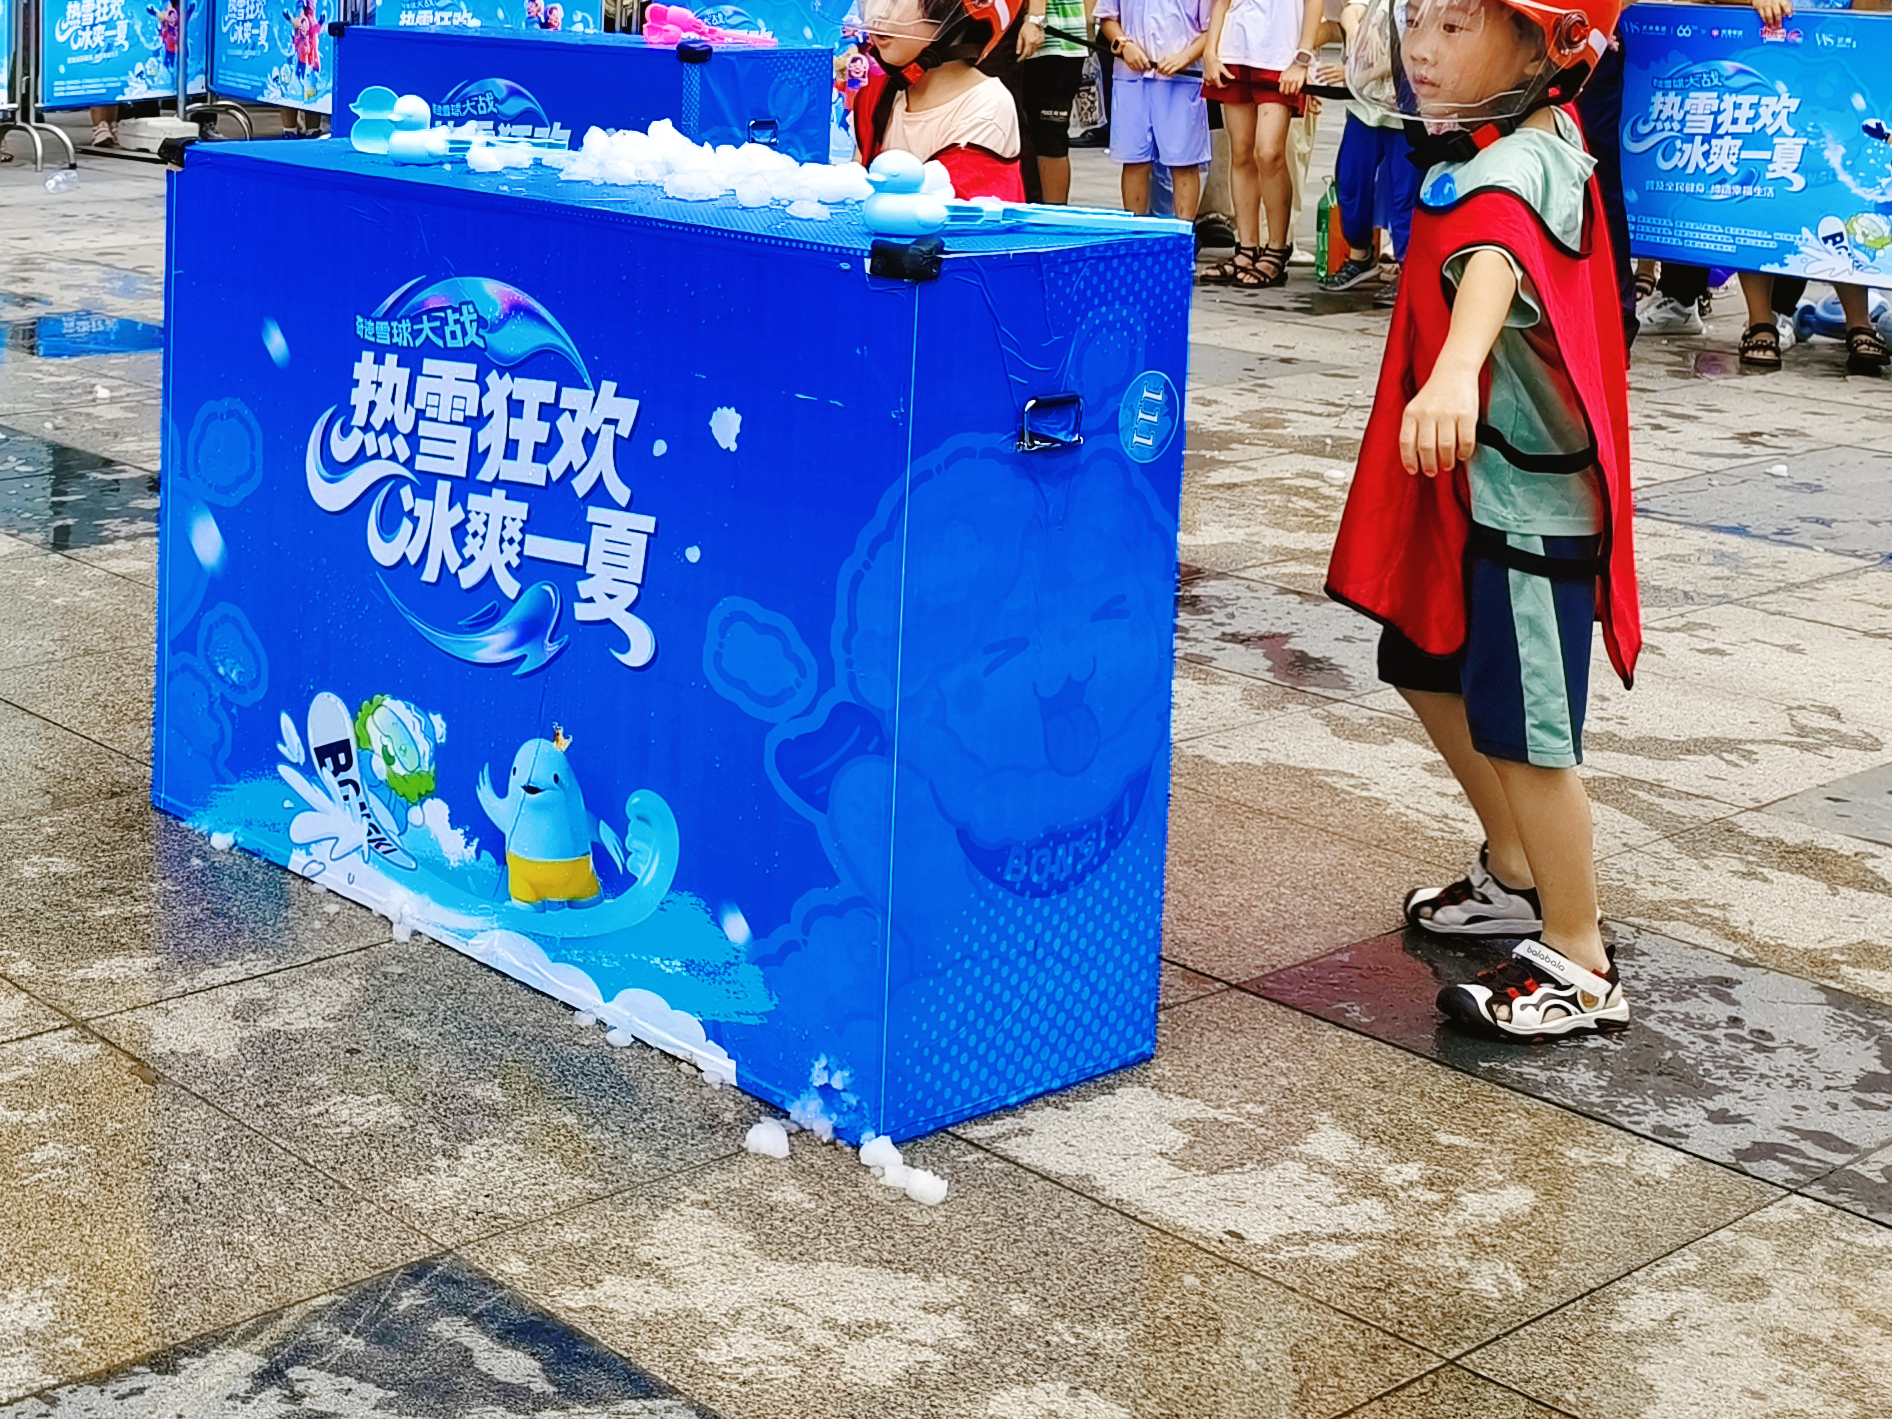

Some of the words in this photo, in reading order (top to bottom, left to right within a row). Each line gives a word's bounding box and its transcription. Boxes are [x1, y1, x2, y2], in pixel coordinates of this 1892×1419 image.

[70, 20, 130, 53] 冰爽一夏
[1648, 91, 1801, 137] 热雪狂欢
[1656, 135, 1809, 193] 冰爽一夏
[349, 349, 641, 508] 热雪狂欢
[366, 479, 657, 669] 冰爽一夏
